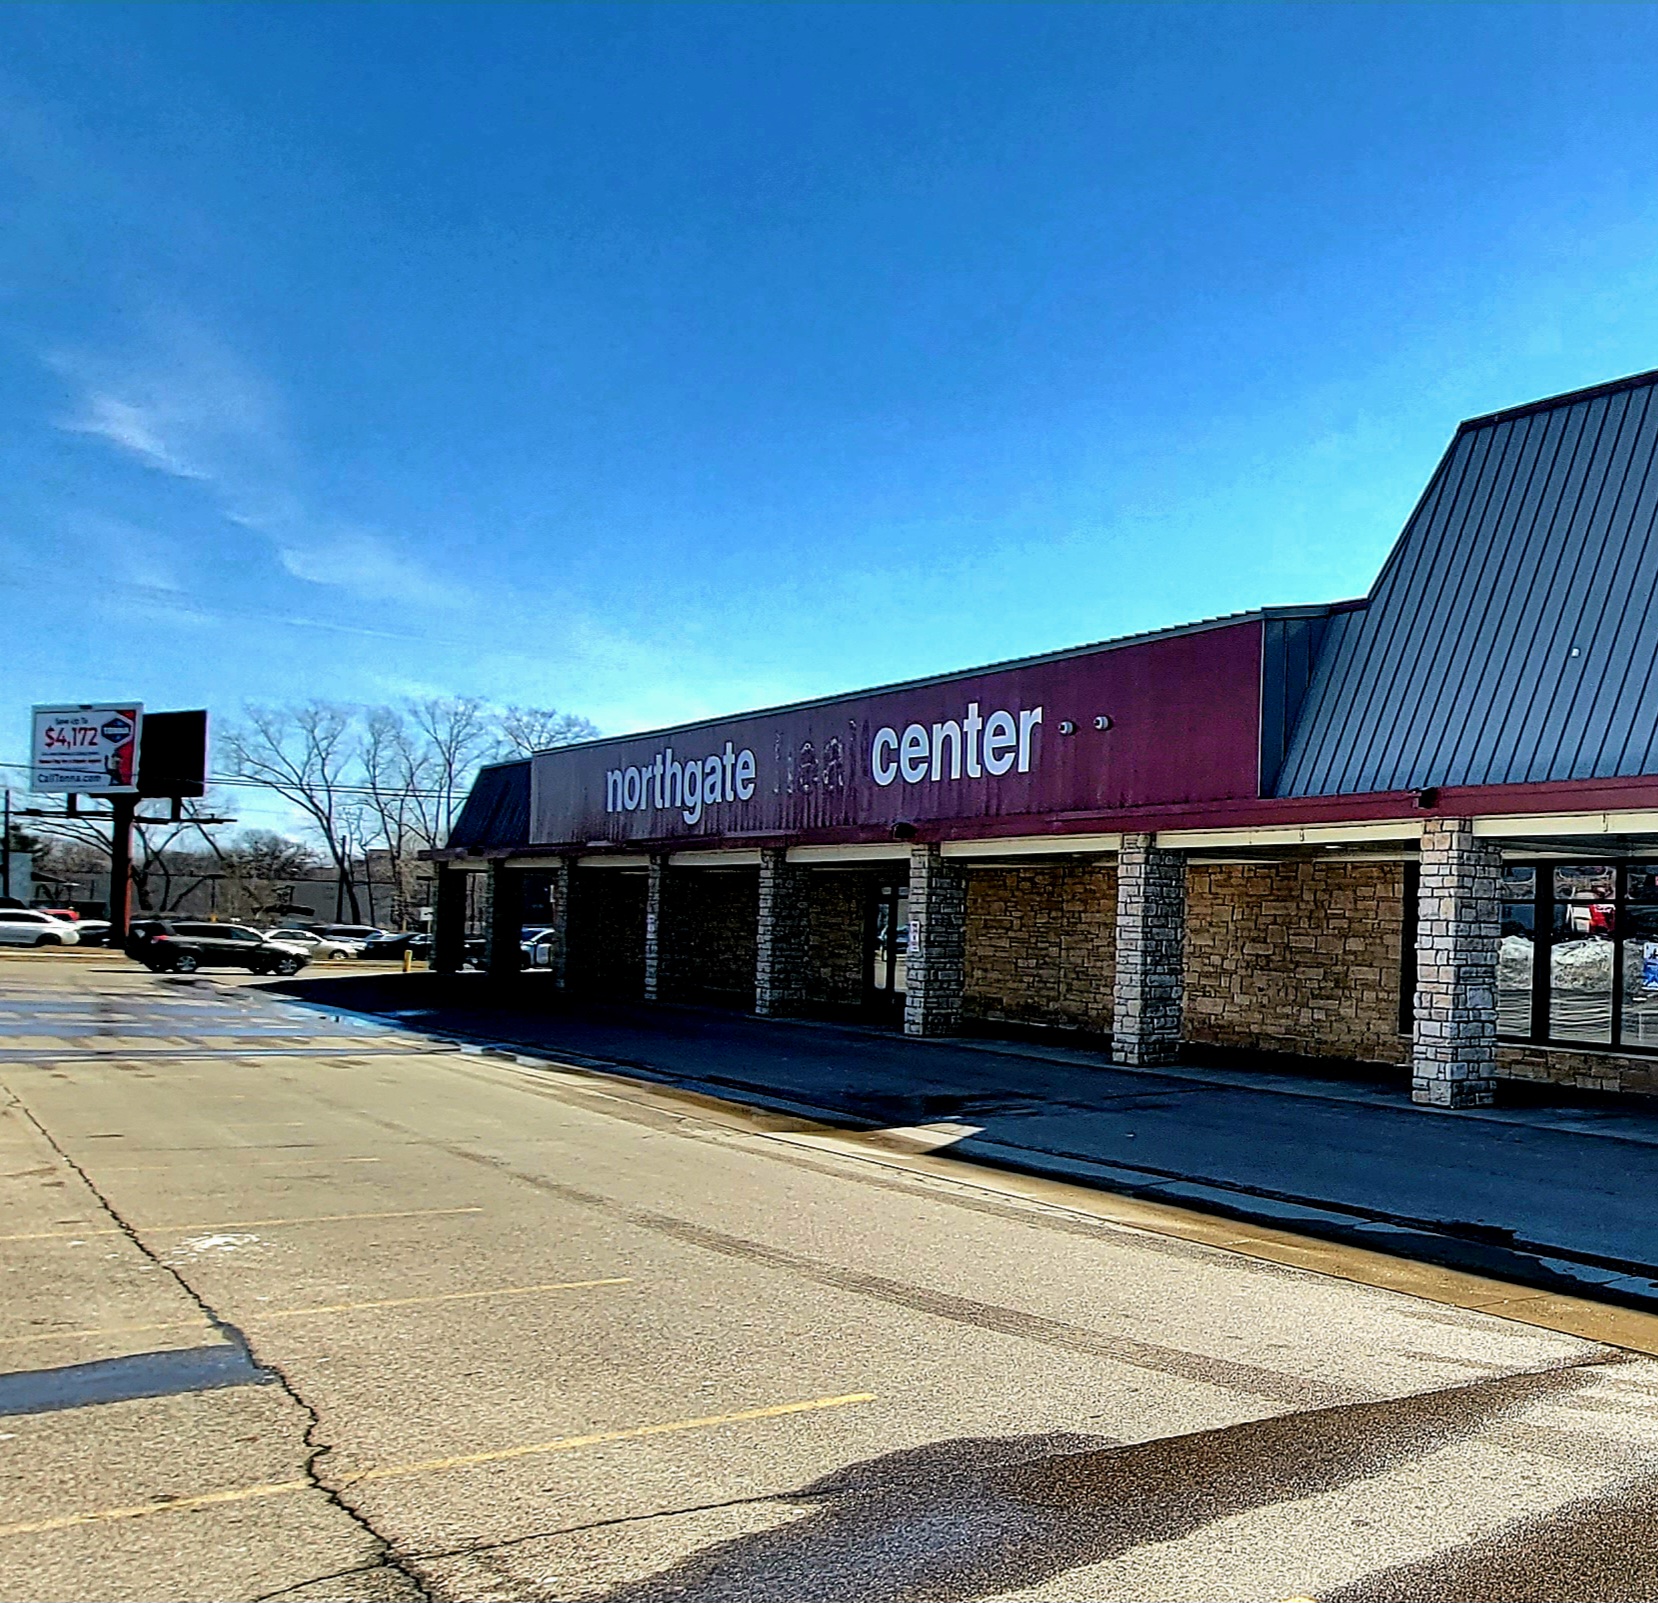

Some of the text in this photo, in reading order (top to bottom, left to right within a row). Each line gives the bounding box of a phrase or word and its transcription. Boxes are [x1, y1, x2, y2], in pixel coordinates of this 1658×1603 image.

[44, 725, 98, 749] $4,172
[606, 741, 757, 825] northgate
[871, 702, 1043, 786] center
